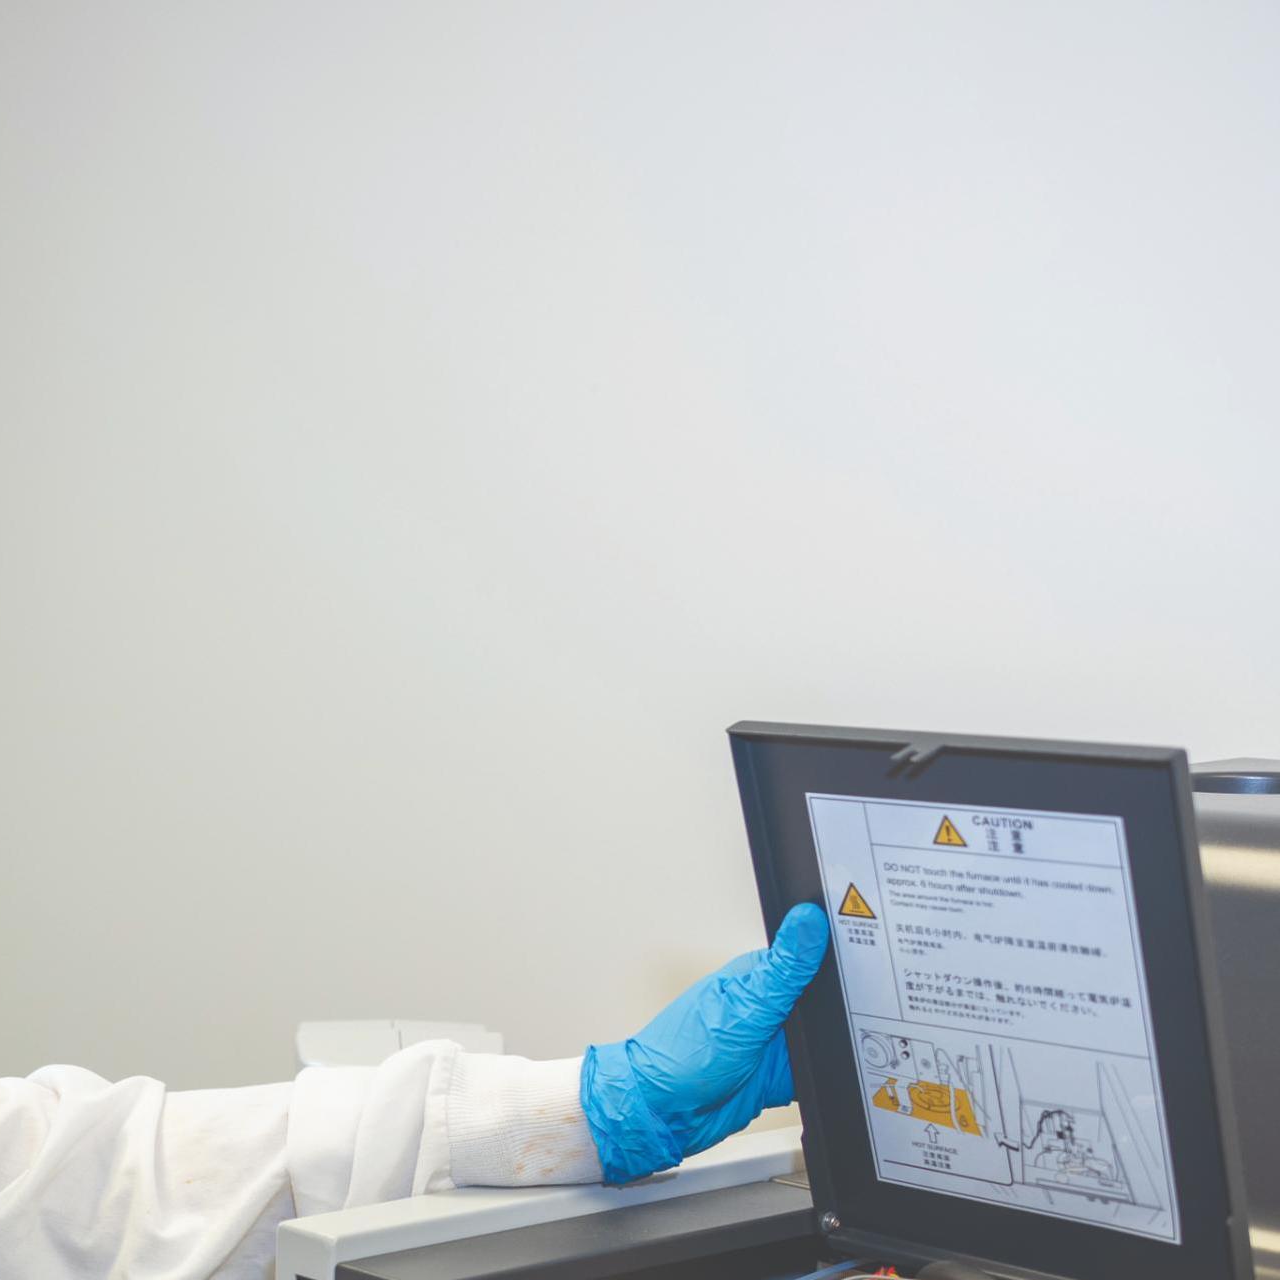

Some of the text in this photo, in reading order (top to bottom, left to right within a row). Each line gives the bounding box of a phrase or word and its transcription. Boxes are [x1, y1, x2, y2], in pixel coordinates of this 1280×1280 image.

[972, 815, 1033, 830] CAUTION
[883, 862, 898, 872] DO
[900, 864, 920, 874] NOT
[922, 867, 947, 877] touch
[949, 869, 964, 879] the
[966, 871, 1000, 882] furnace
[1002, 875, 1022, 885] until
[1031, 878, 1049, 887] has
[1051, 880, 1083, 891] cooled
[886, 877, 917, 889] approx.
[920, 880, 927, 888] 6
[928, 881, 954, 891] hours
[955, 884, 976, 893] after
